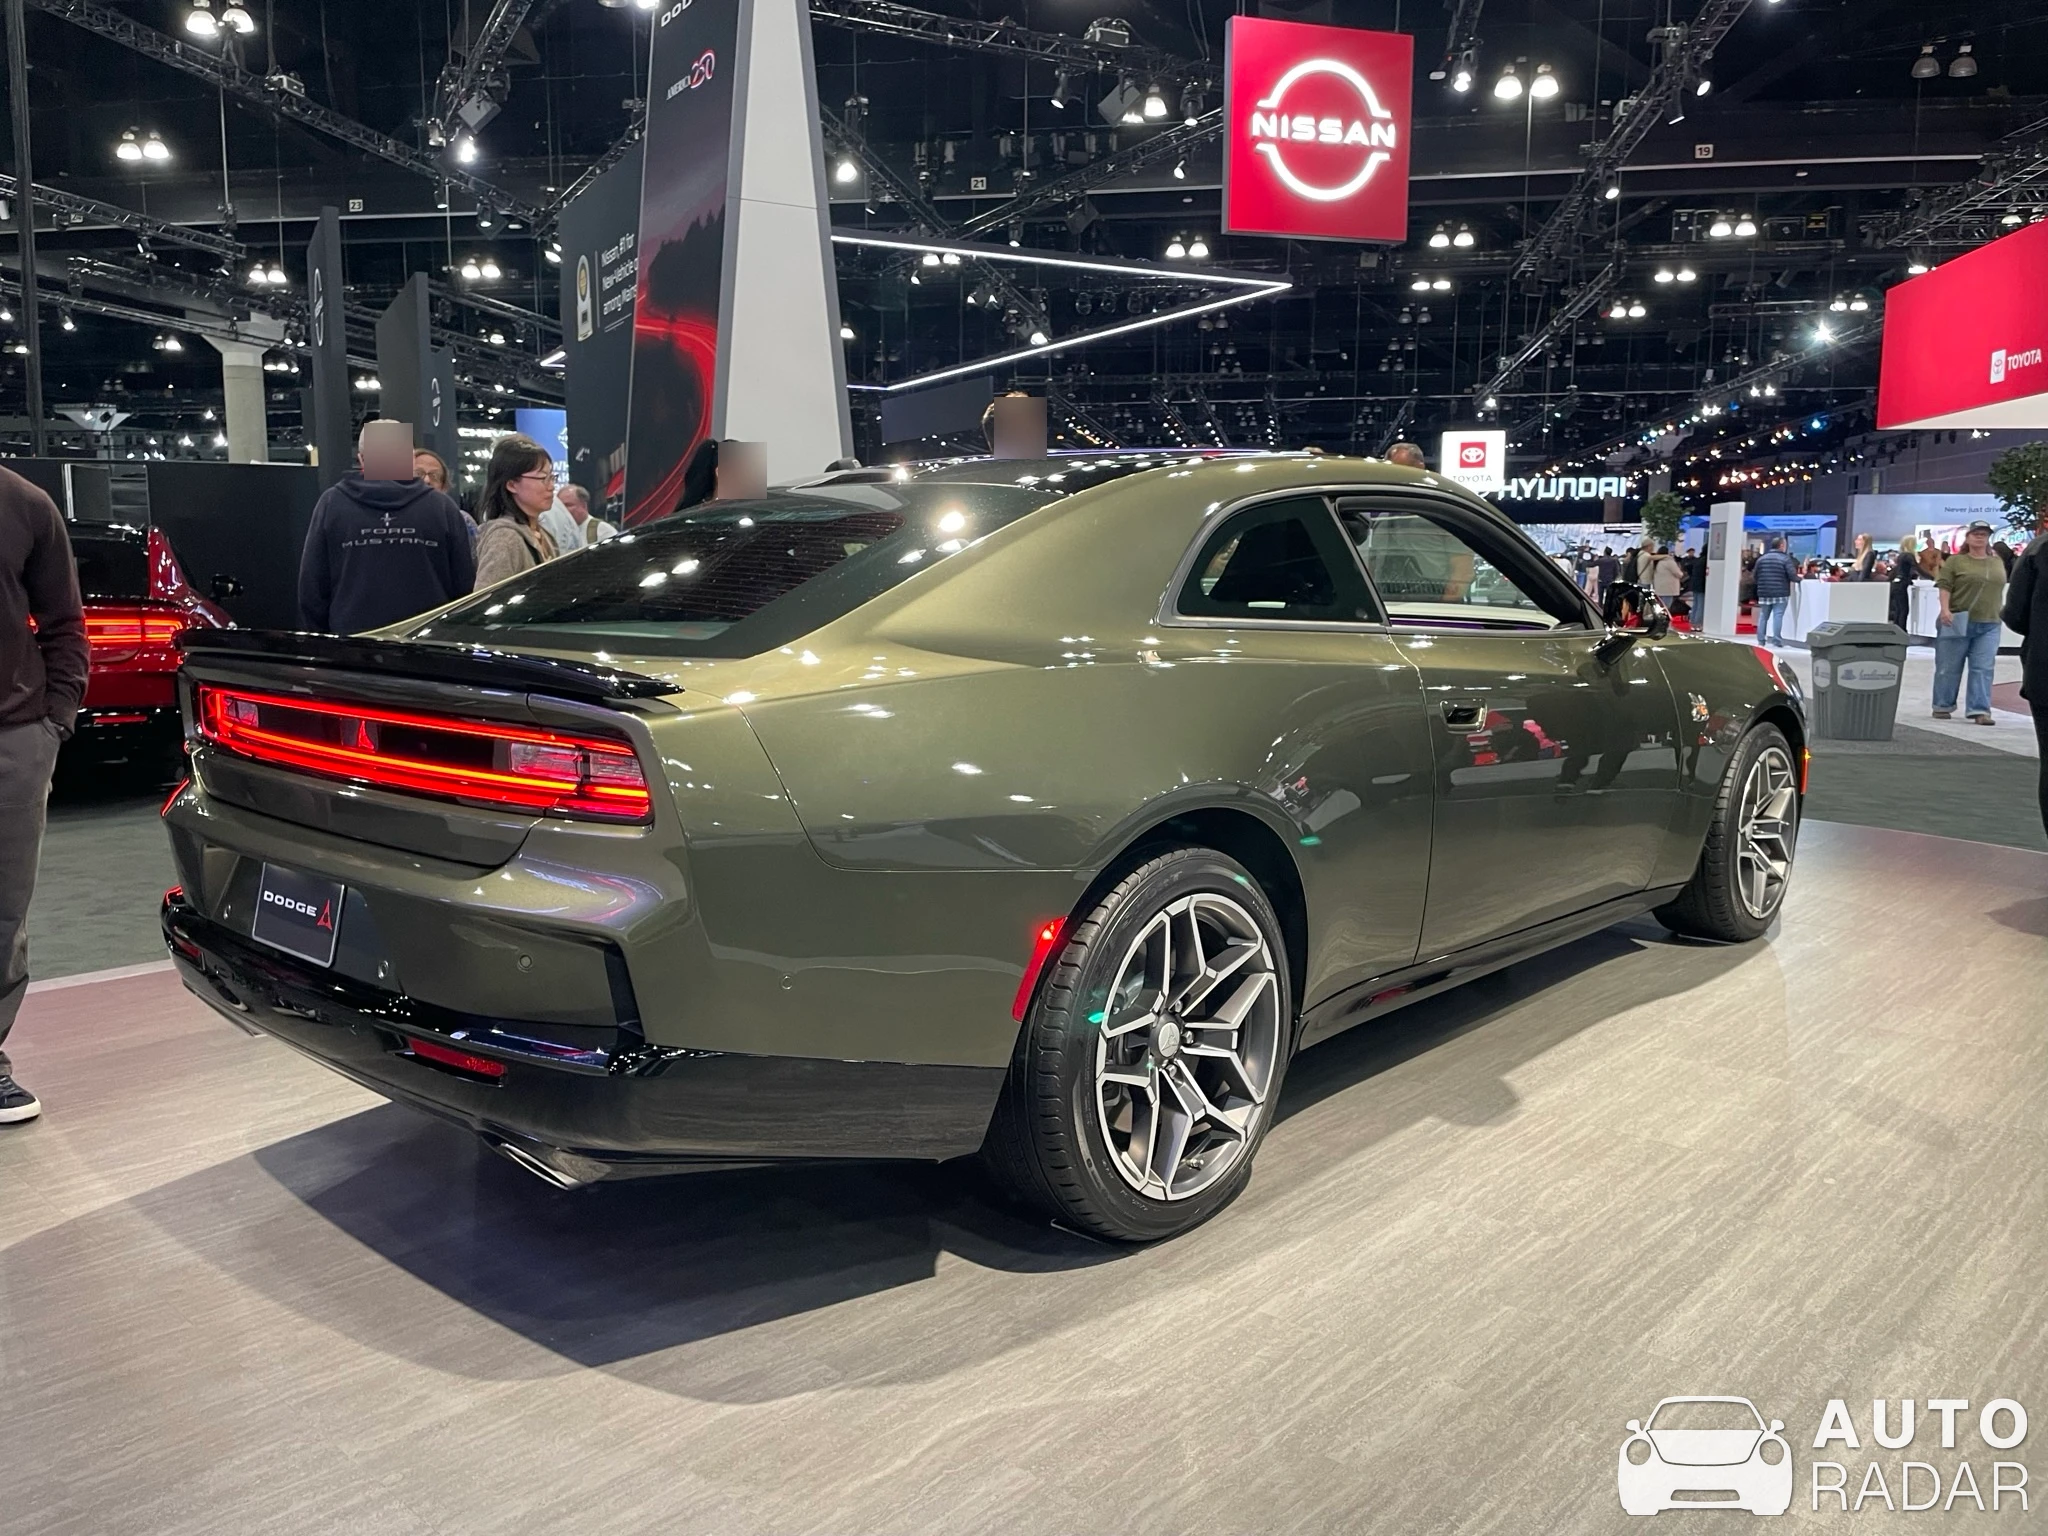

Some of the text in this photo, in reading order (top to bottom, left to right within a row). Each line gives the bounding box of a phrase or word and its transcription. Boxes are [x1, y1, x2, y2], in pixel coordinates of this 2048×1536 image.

[661, 0, 693, 27] DOD
[1252, 111, 1396, 148] NISSAN
[1697, 146, 1710, 156] 19
[973, 179, 985, 189] 21
[2007, 348, 2042, 371] TOYOTA
[1453, 475, 1493, 483] TOYOTA
[1499, 477, 1627, 499] HYUNDAI
[1967, 506, 1983, 514] just
[342, 538, 438, 548] MUSTANG
[263, 890, 317, 917] DODGE
